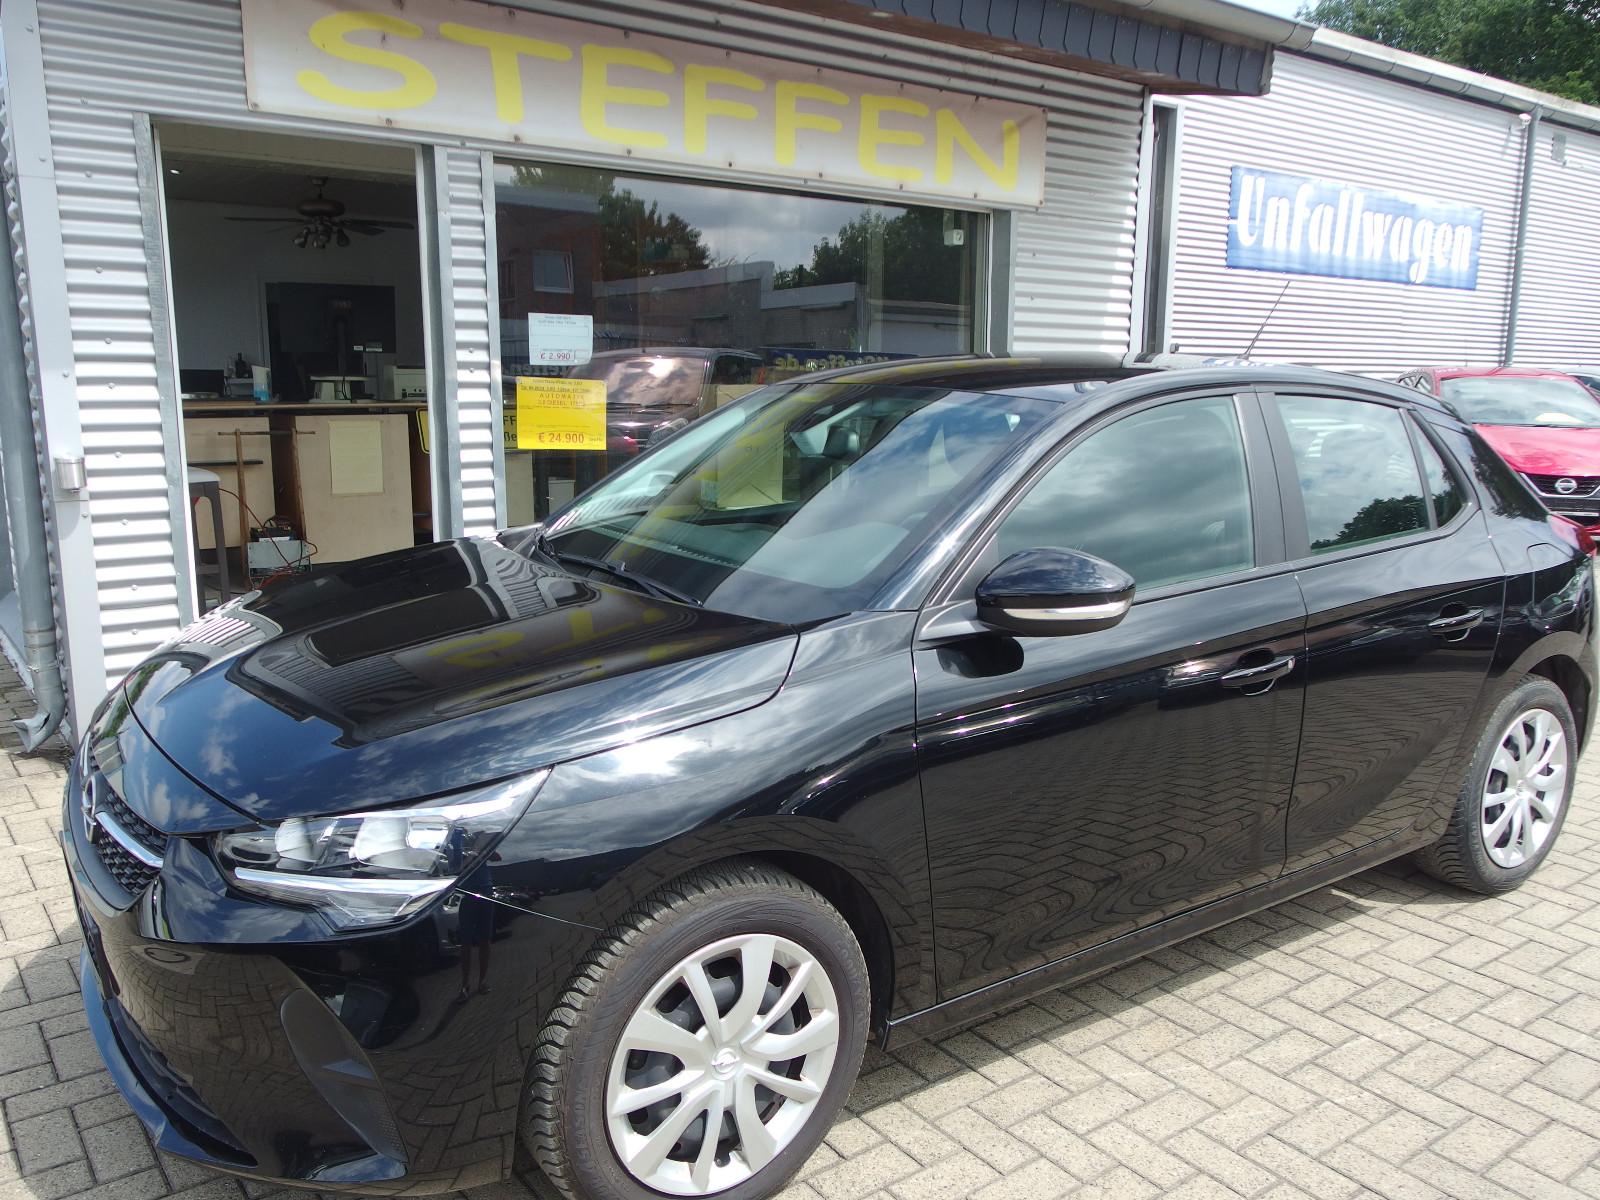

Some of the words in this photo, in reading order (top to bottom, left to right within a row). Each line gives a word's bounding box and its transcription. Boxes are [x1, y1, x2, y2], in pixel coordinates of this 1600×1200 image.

[296, 11, 1020, 191] STEFFEN
[1237, 174, 1472, 283] Unfallwagen
[548, 352, 571, 361] 2.990
[538, 432, 545, 443] €
[548, 432, 585, 444] 24.900
